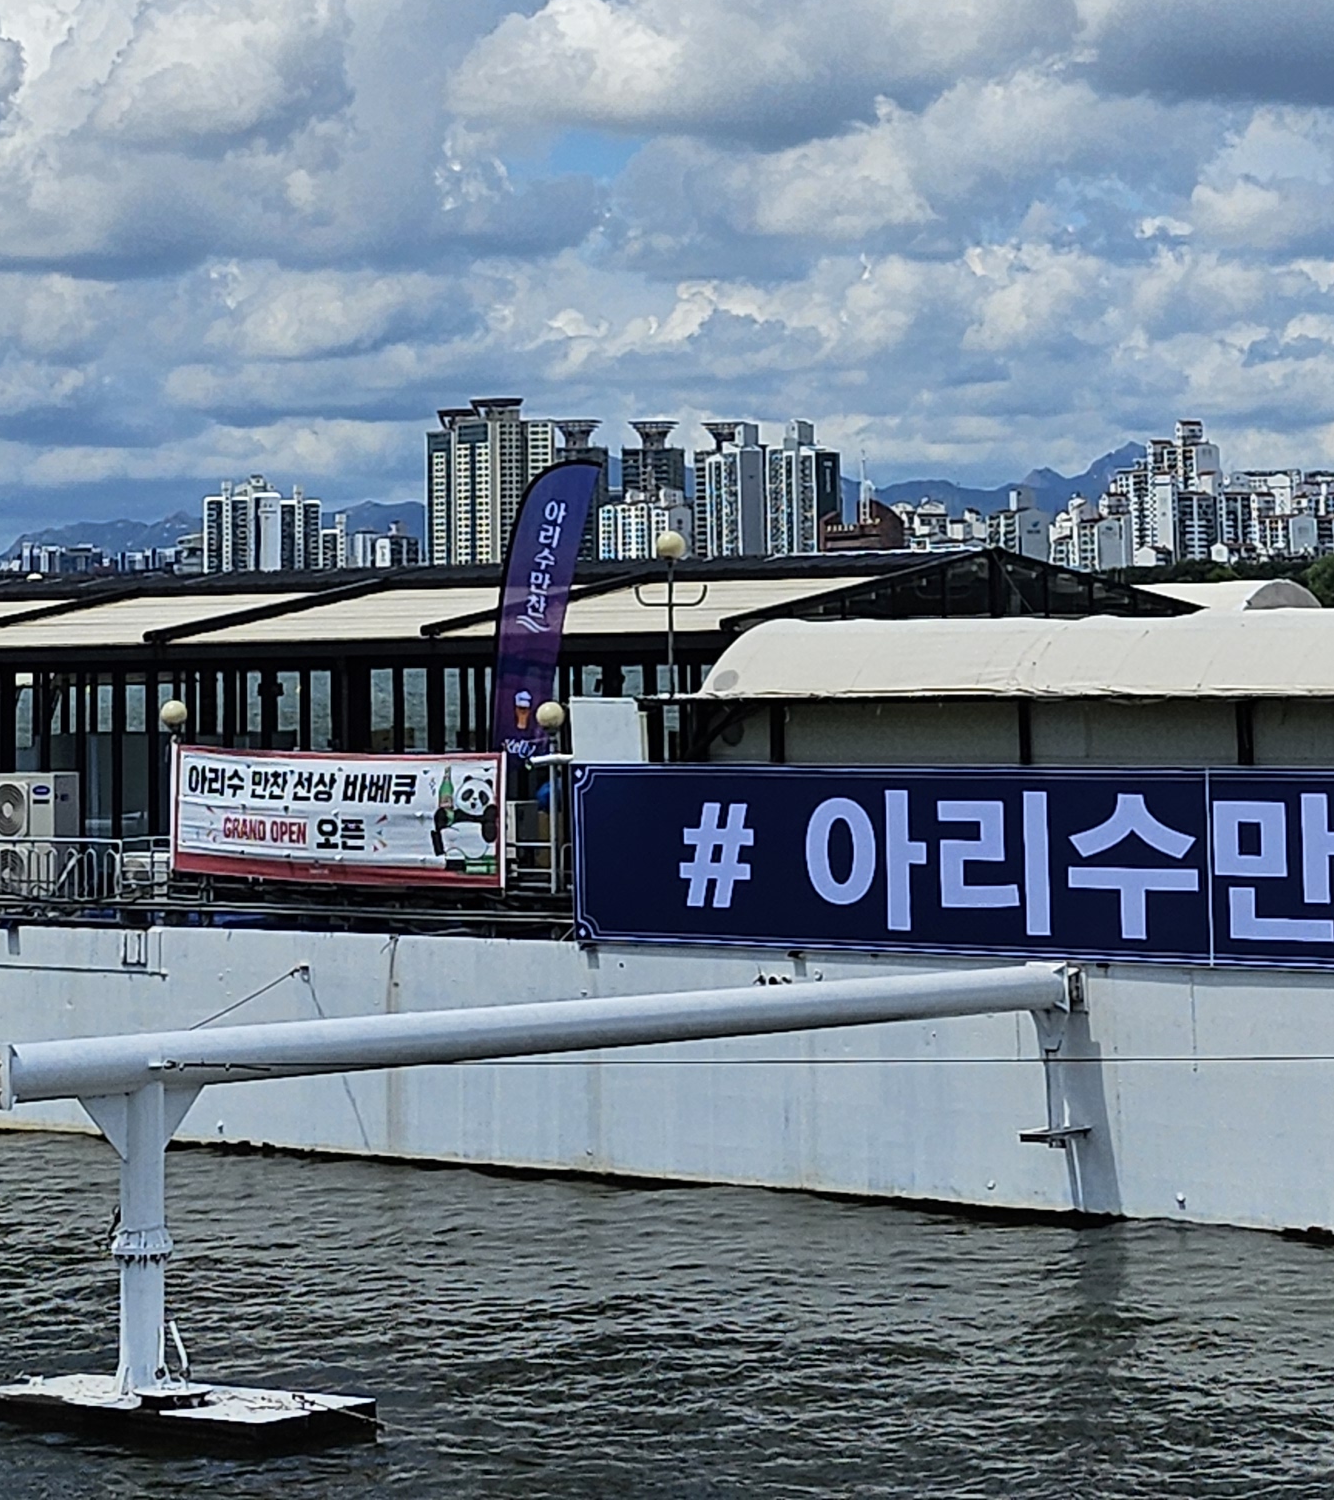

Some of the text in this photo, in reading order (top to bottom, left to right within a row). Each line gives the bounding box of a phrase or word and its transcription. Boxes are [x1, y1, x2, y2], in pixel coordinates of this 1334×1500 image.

[525, 500, 567, 619] 아리수만찬
[188, 765, 418, 805] 아리수 만찬 선상 바베큐
[223, 816, 365, 850] GRAND OPEN 오픈
[679, 802, 755, 908] #
